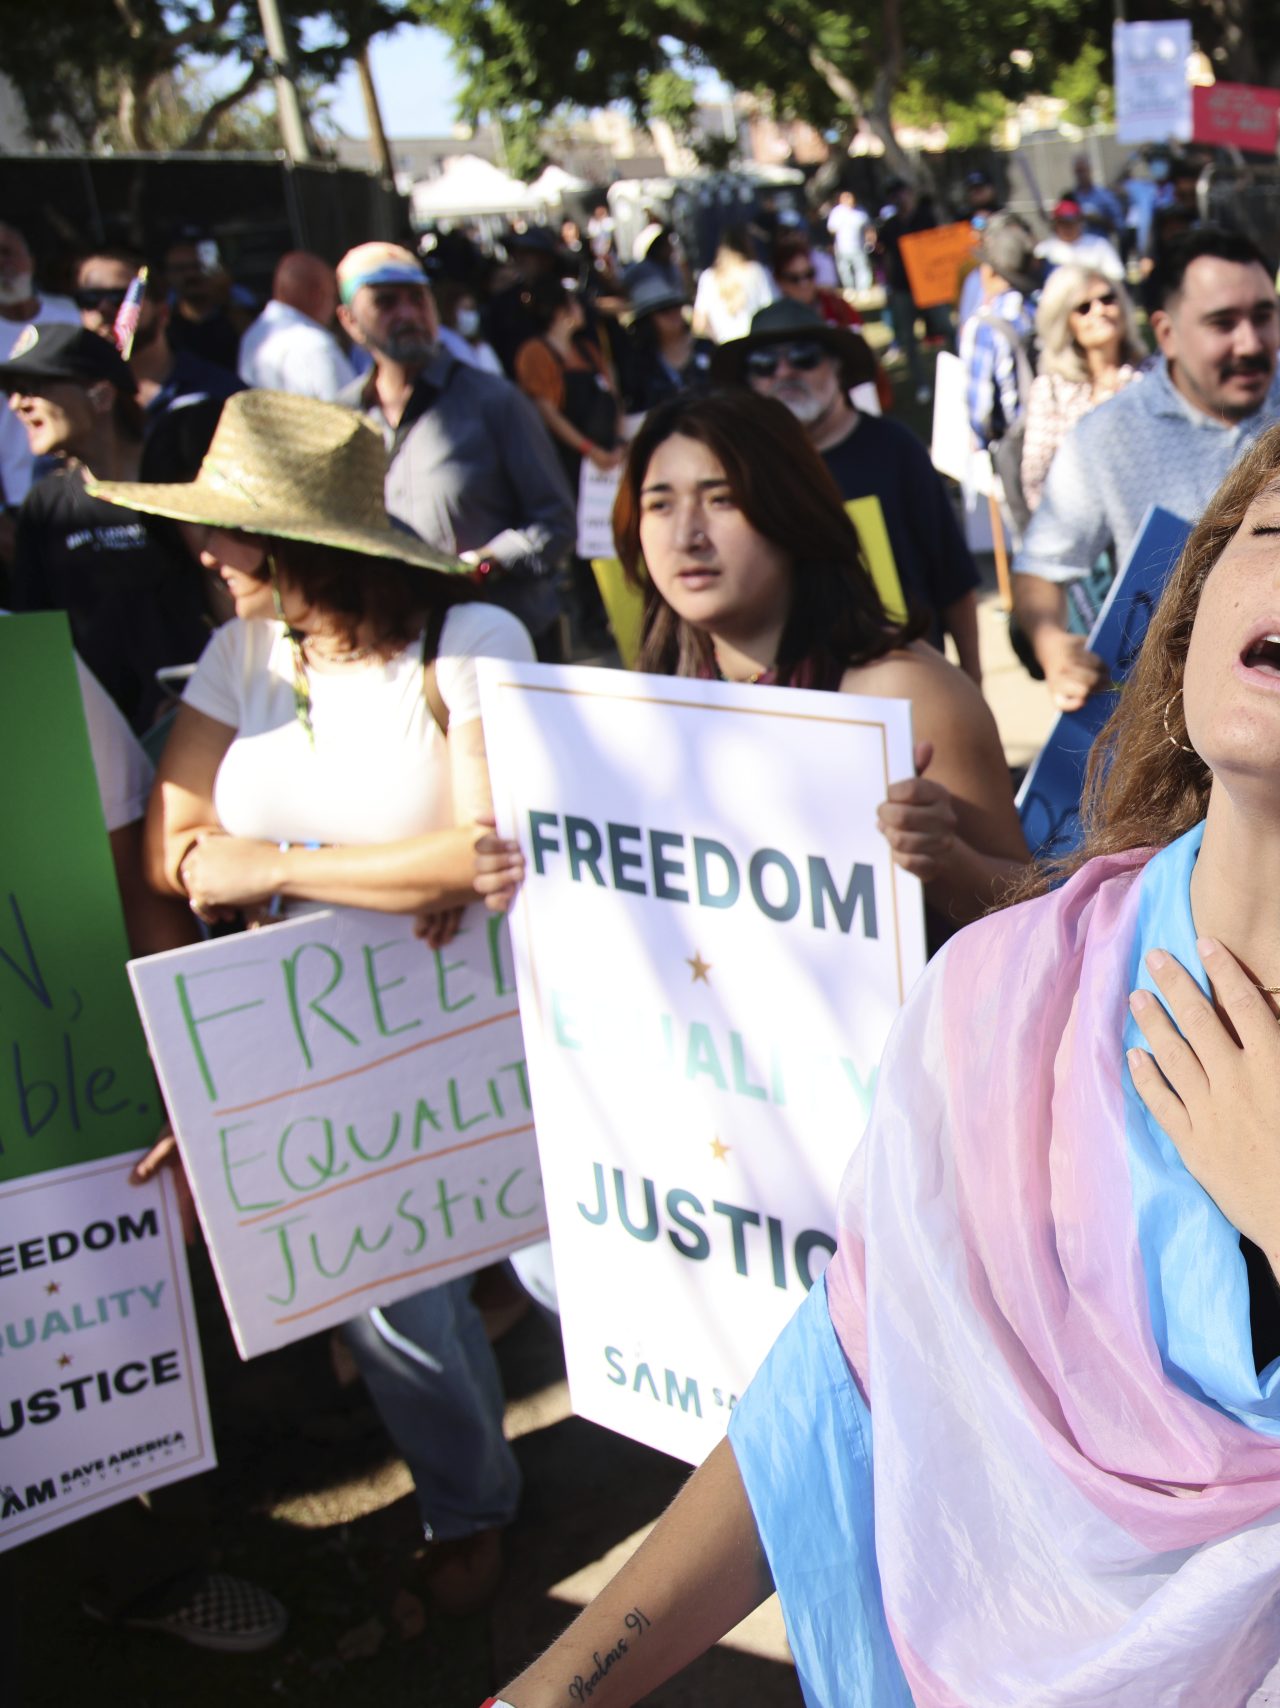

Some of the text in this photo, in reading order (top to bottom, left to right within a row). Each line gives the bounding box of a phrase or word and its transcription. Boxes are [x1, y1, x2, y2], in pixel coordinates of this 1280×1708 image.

[528, 809, 879, 940] FREEDOM
[0, 1279, 167, 1360] UALITY
[604, 1344, 703, 1419] SAM
[60, 1460, 105, 1484] SAVE
[108, 1430, 185, 1468] AMERICA
[624, 1606, 651, 1636] 91
